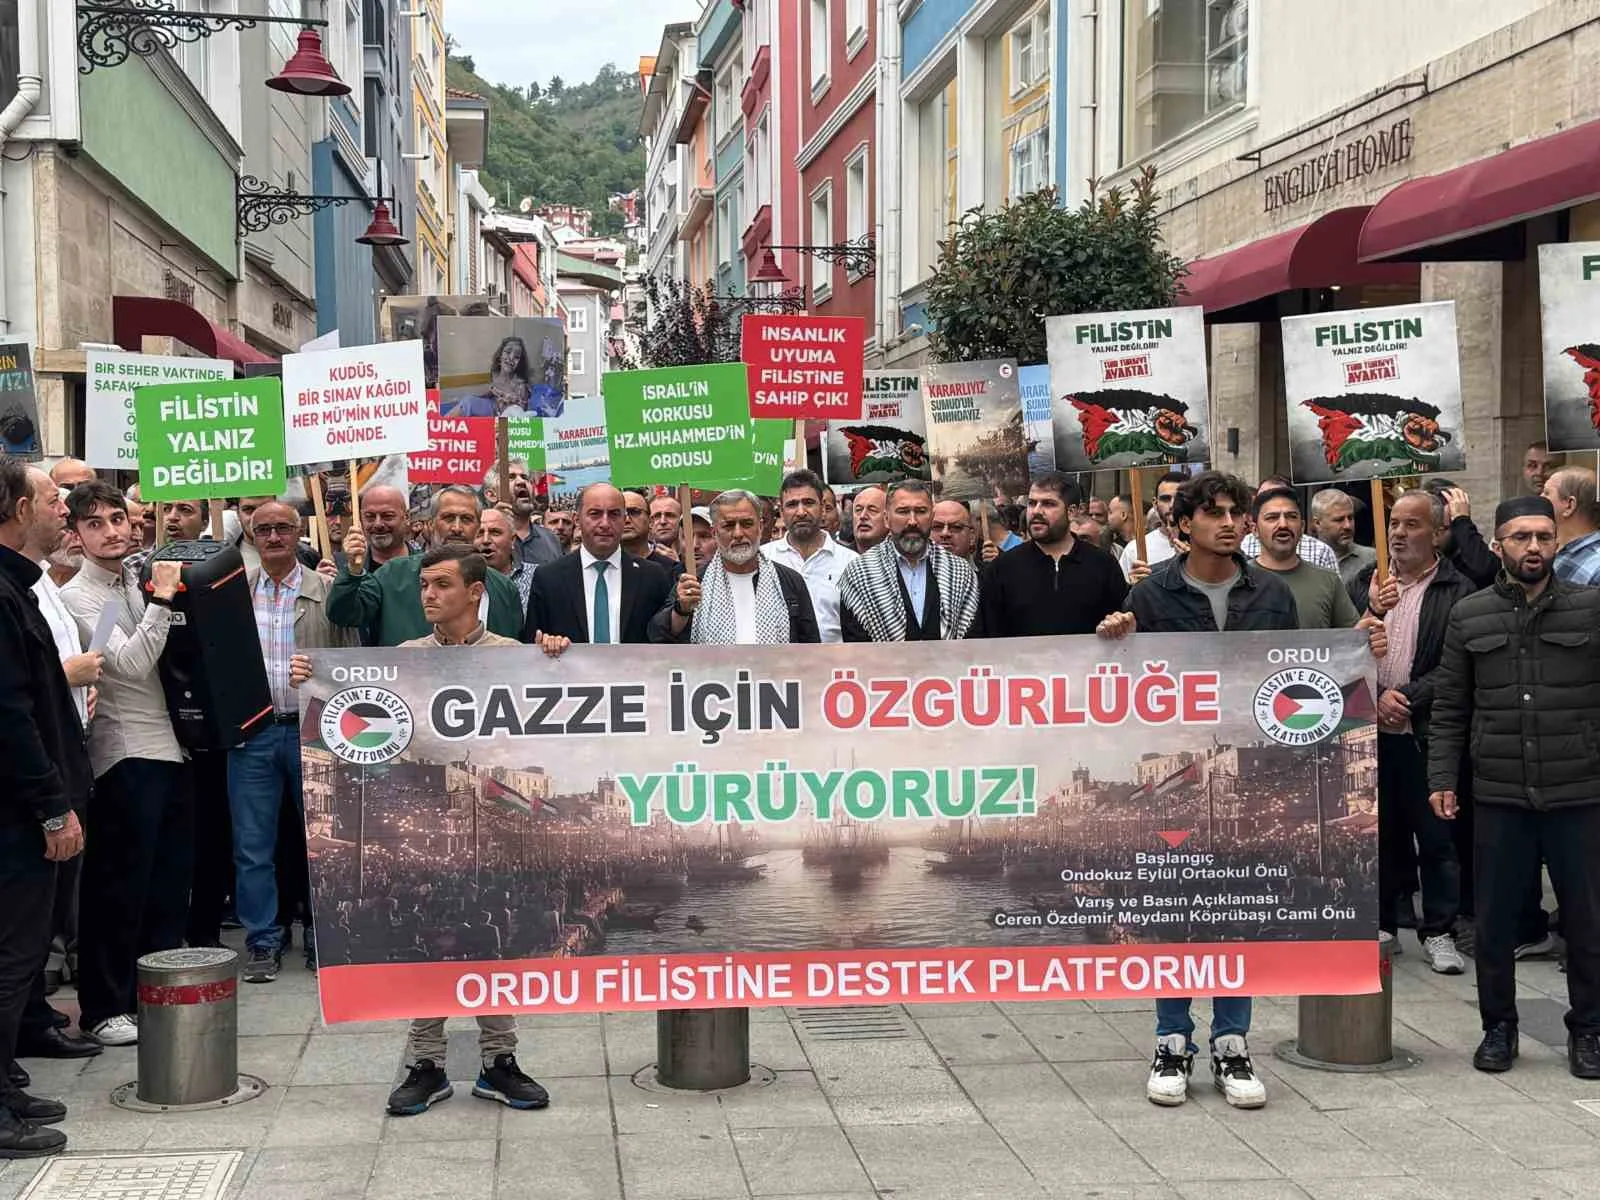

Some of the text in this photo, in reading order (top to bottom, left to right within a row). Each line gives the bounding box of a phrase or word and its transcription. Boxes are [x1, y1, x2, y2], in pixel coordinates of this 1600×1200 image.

[1264, 118, 1411, 213] ENGLISH HOME
[761, 326, 847, 343] İNSANLIK
[1075, 318, 1172, 344] FİLİSTİN
[1315, 318, 1422, 347] FİLİSTİN
[770, 348, 836, 364] UYUMA
[1332, 346, 1362, 356] YALNIZ
[95, 362, 115, 374] BİR
[119, 365, 159, 377] SEHER
[329, 361, 378, 382] KUDÜS,
[761, 369, 844, 385] FİLİSTİNE
[298, 379, 411, 407] BİR SINAV KAĞIDI
[643, 381, 709, 400] İSRAİL'İN
[863, 376, 919, 391] LİSTİN
[928, 381, 986, 398] KARARLIYIZ
[159, 392, 259, 423] FİLİSTİN
[755, 390, 848, 408] SAHİP ÇIK!
[292, 412, 319, 428] HER
[322, 404, 370, 425] MÜ'MİN
[374, 400, 418, 420] KULUN
[642, 404, 713, 424] KORKUSU
[167, 428, 256, 453] YALNIZ
[326, 426, 387, 445] ÖNÜNDE.
[614, 424, 745, 449] HZ.MUHAMMED'İN
[447, 458, 481, 476] ÇIK!
[651, 451, 713, 469] ORDUSU
[152, 456, 273, 487] DEĞİLDİR!
[1267, 647, 1330, 664] ORDU
[331, 666, 398, 682] ORDU
[1308, 673, 1341, 705] DESTEK
[375, 691, 409, 724] DESTEK
[430, 660, 1221, 744] GAZZE İÇİN ÖZGÜRLÜĞE
[1268, 723, 1330, 743] PLATFORMU
[334, 741, 400, 762] PLATFORMU
[617, 760, 1038, 825] YÜRÜYORUZ!
[1060, 862, 1288, 882] Ondokuz Eylül Ortaokul Önü
[1075, 894, 1279, 910] Varış ve Basın Açıklaması
[994, 904, 1356, 926] Ceren Özdemir Meydanı Köprübaşı Cami Önü
[455, 954, 1246, 1009] ORDU FİLİSTİNE DESTEK PLATFORMU
